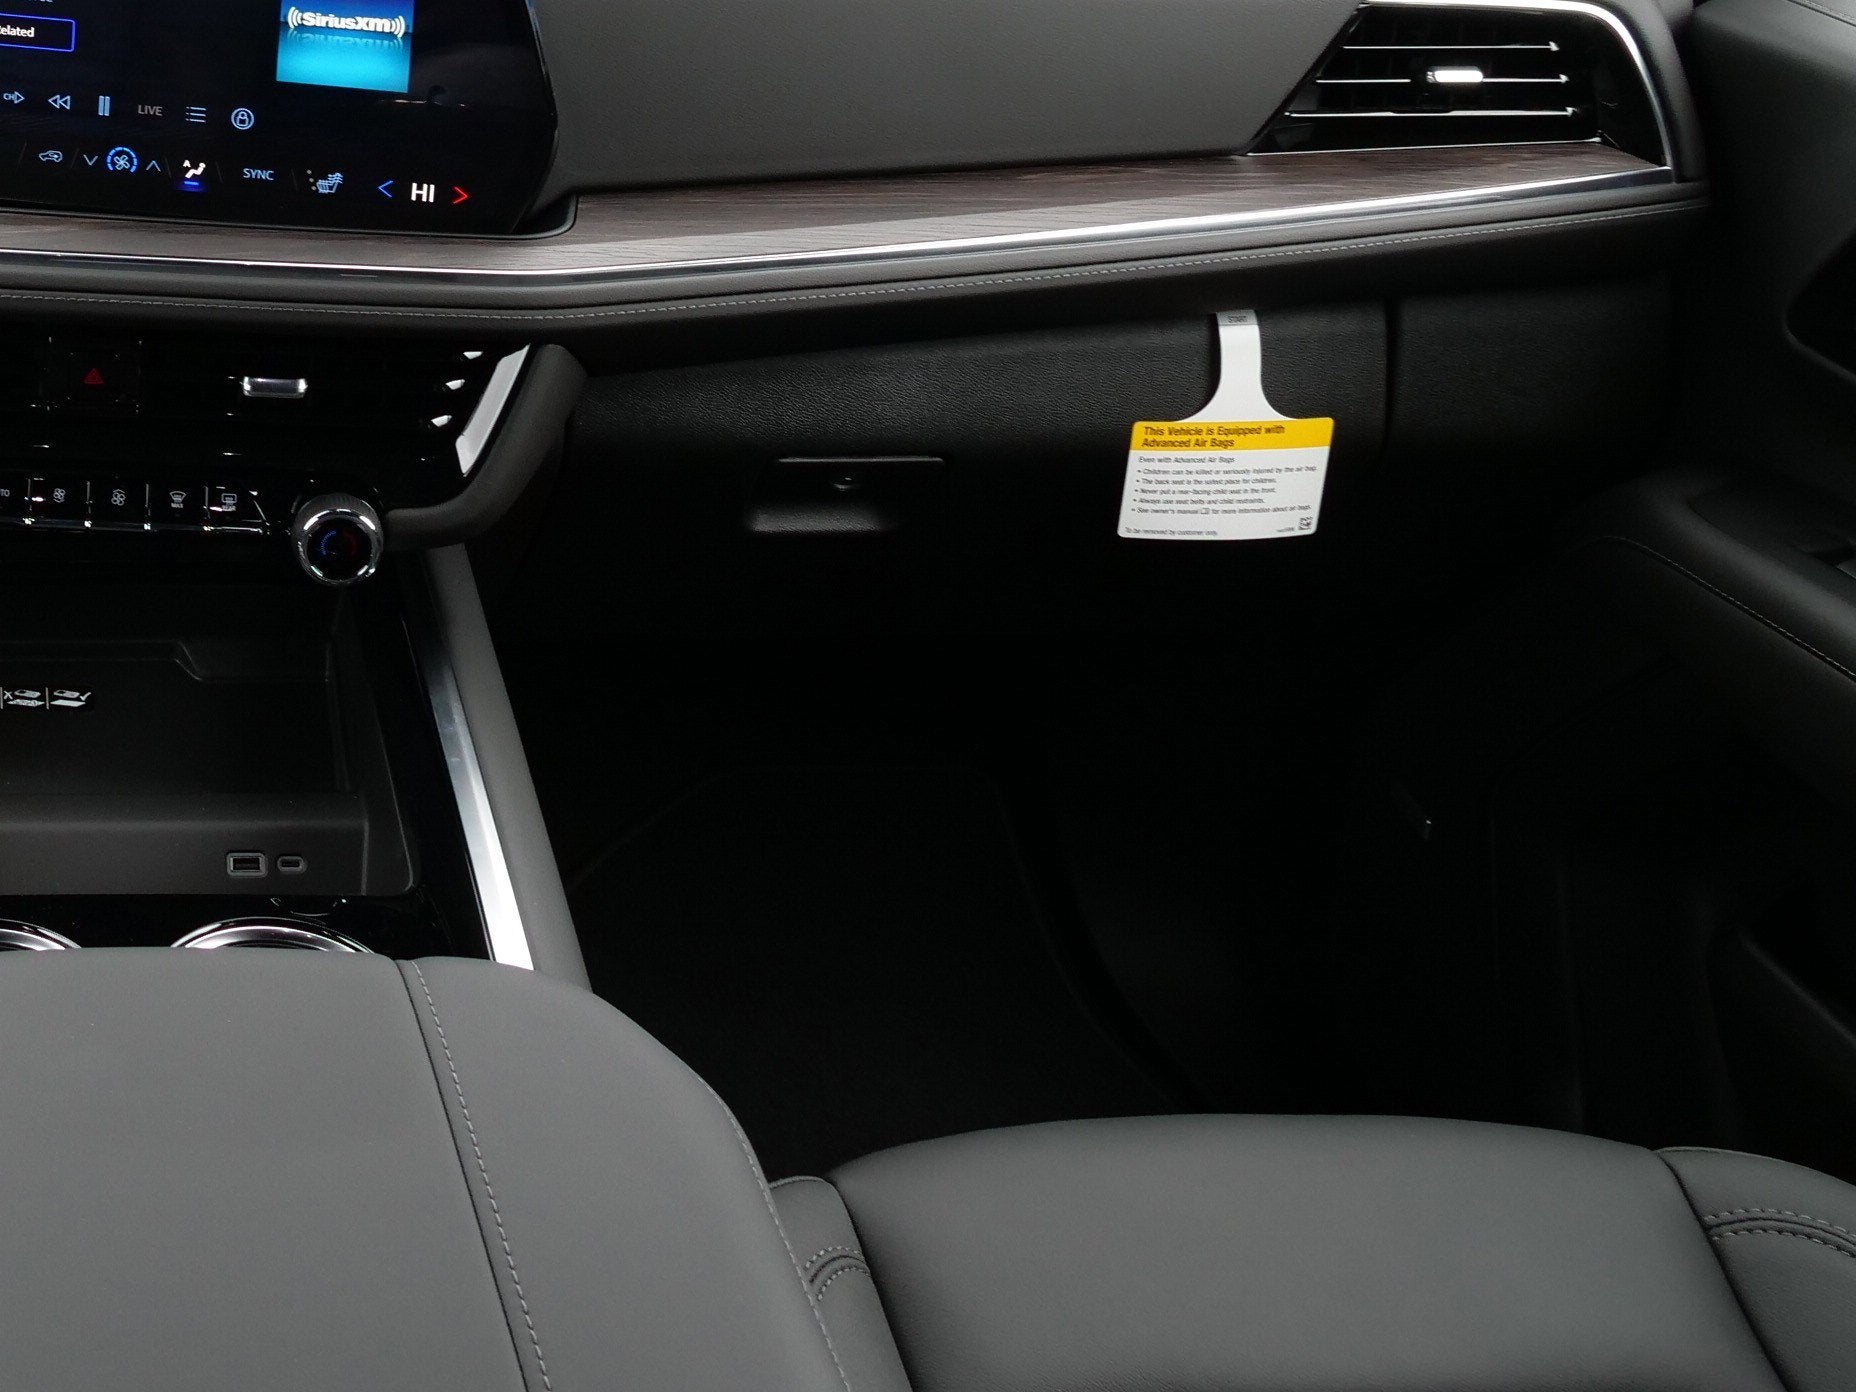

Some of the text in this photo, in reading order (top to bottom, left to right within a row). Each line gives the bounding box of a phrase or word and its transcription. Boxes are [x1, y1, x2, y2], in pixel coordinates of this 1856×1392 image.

[3, 92, 15, 101] CH
[137, 104, 163, 117] LIVE
[243, 167, 275, 182] SYNC
[410, 183, 436, 203] HI
[1143, 426, 1165, 436] This
[1167, 426, 1204, 436] Vehicle
[1217, 425, 1262, 438] Equipped
[1264, 424, 1286, 434] with
[1141, 437, 1235, 449] Advanced Air Bags
